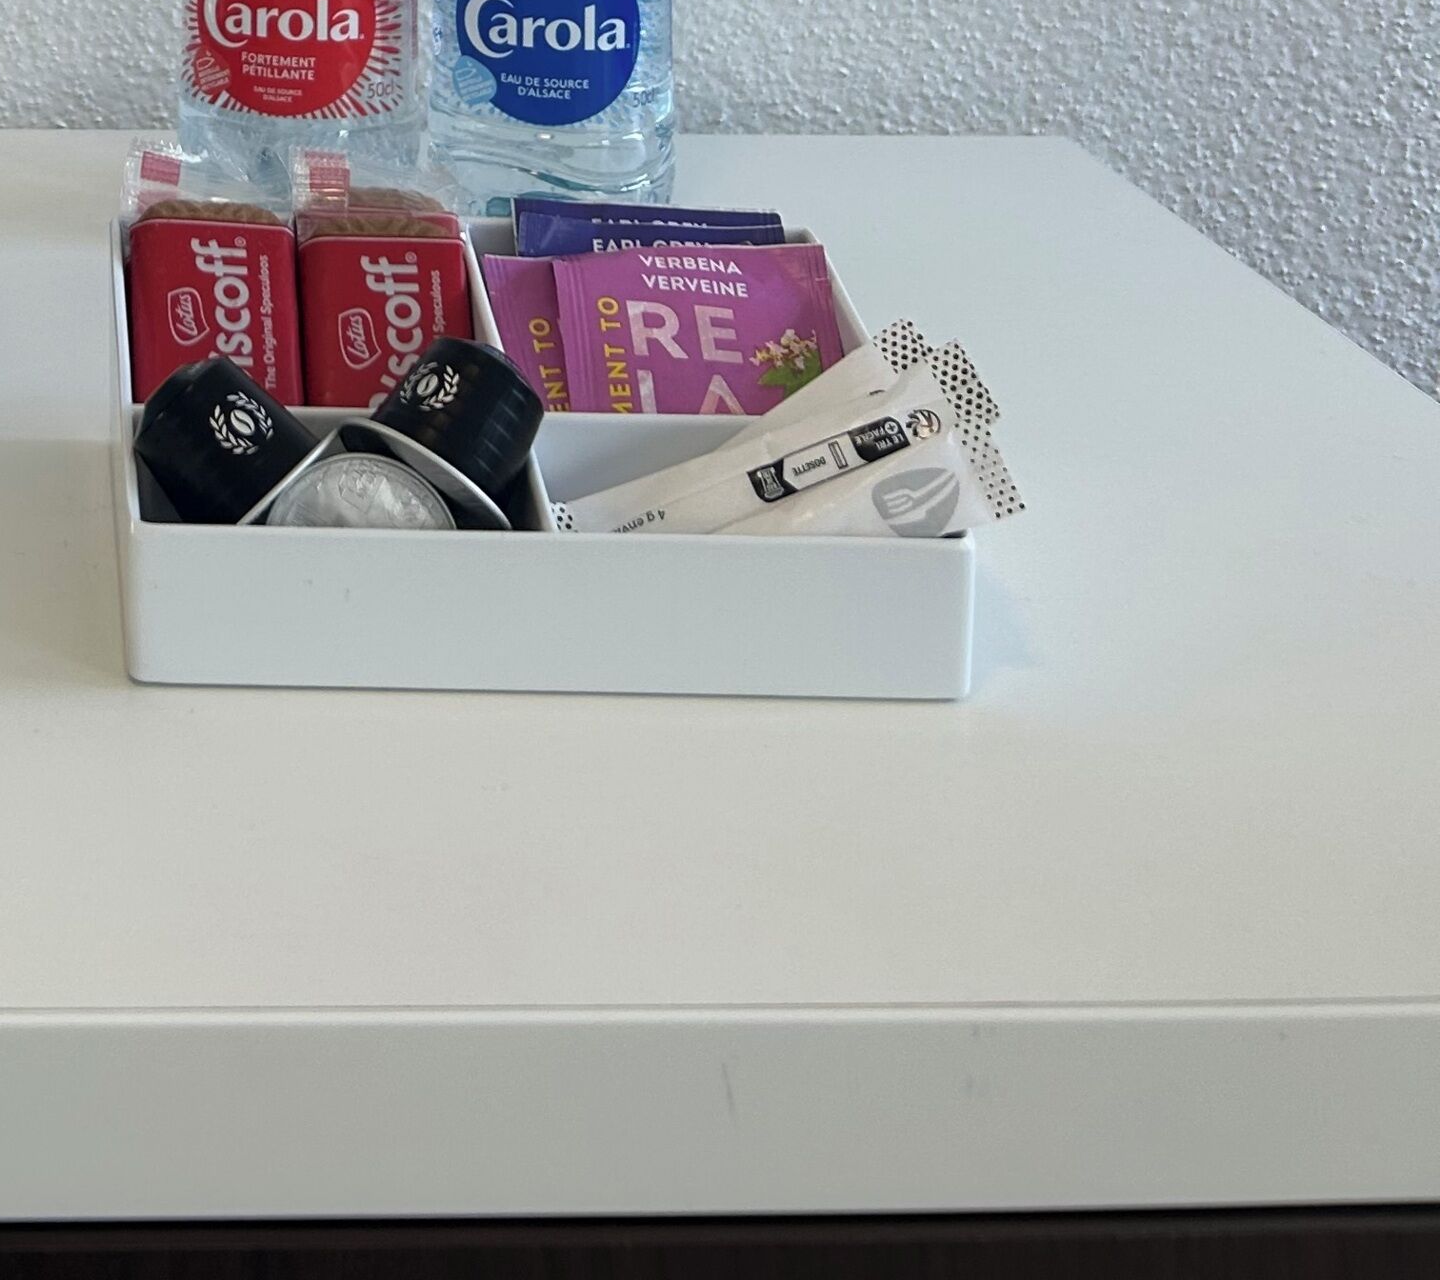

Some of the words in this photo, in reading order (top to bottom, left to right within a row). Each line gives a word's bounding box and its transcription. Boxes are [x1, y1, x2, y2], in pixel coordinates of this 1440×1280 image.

[241, 51, 316, 68] FORTEMENT
[242, 63, 315, 81] PÉTILLANTE
[500, 72, 522, 85] EAU
[524, 76, 540, 87] DE
[543, 77, 590, 89] SOURCE
[517, 86, 572, 100] D'ALSACE
[638, 253, 743, 276] VERBENA
[259, 254, 274, 315] Speculoos
[641, 273, 750, 299] VERVEINE
[431, 269, 447, 333] Speculoos
[175, 292, 199, 337] Lotus
[597, 297, 622, 332] TO
[262, 315, 277, 365] Original
[346, 314, 370, 359] Lotus
[528, 318, 555, 354] TO
[626, 299, 744, 365] RE
[264, 365, 277, 390] The
[876, 436, 893, 451] TRI
[893, 432, 904, 442] LE
[792, 456, 827, 476] DOSETTE
[646, 510, 656, 522] g
[657, 509, 665, 521] 4
